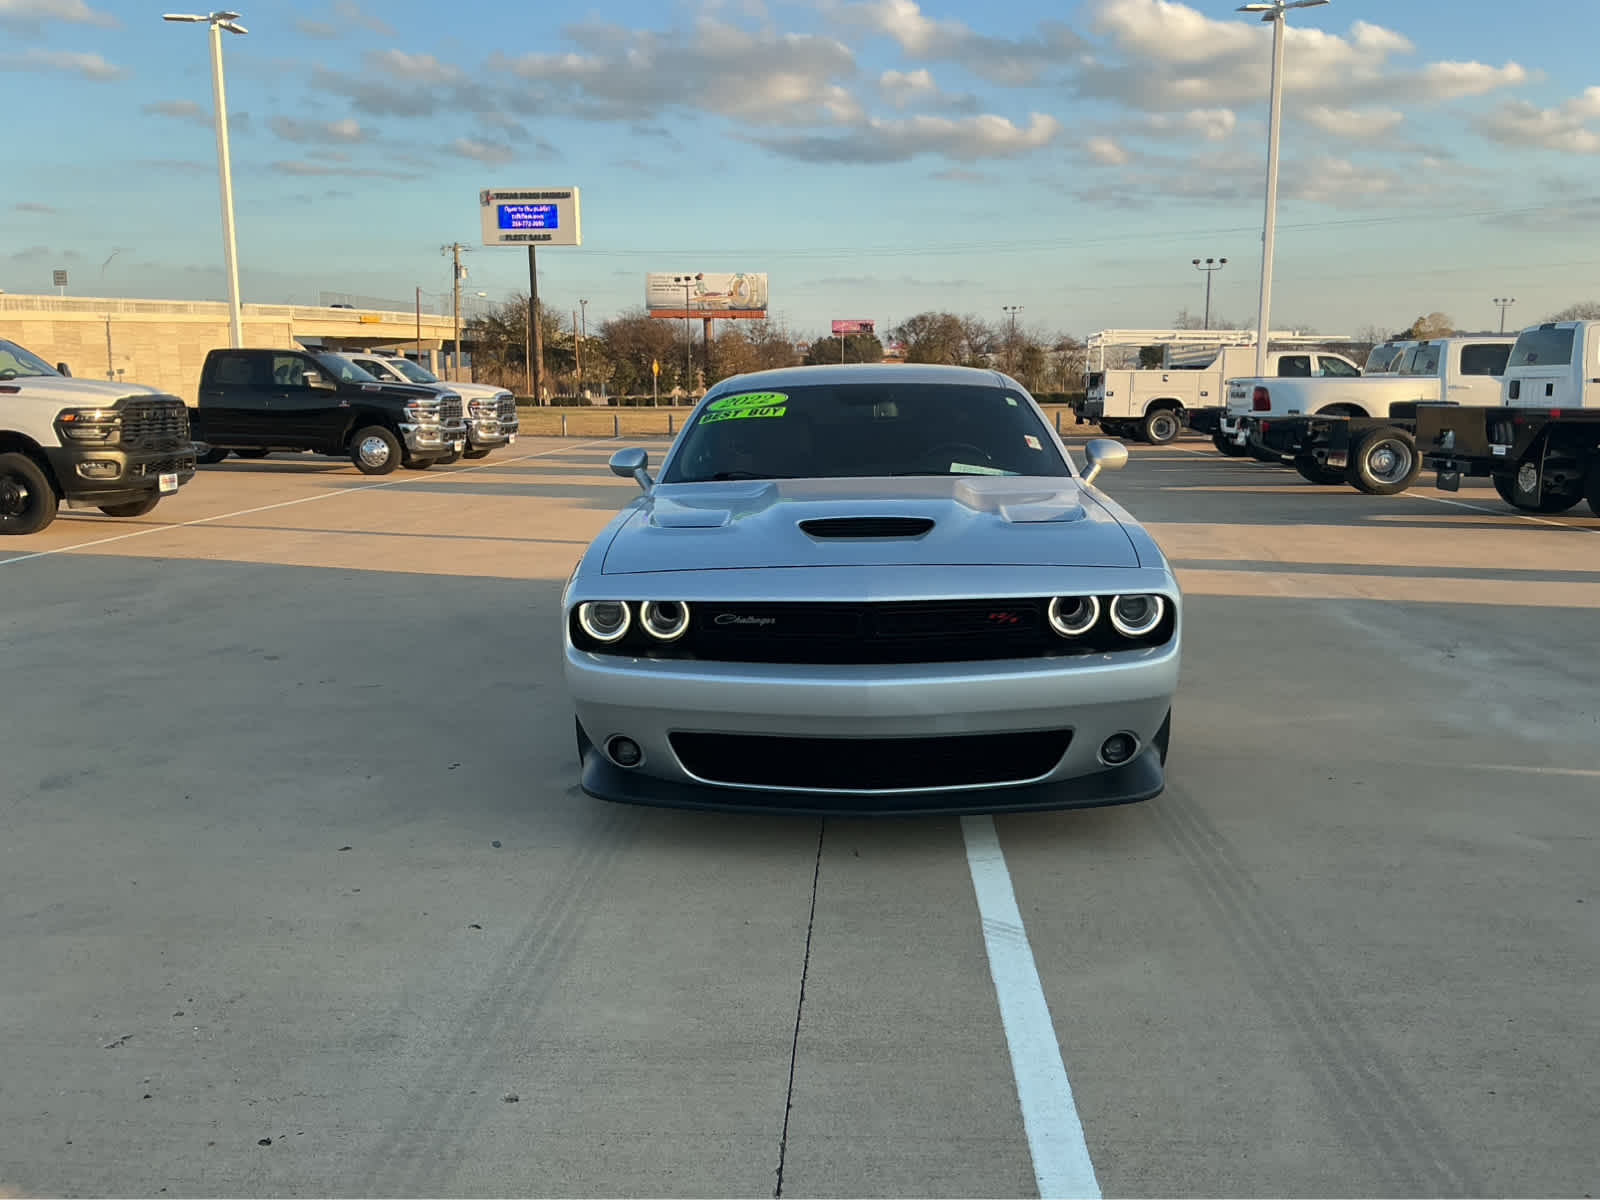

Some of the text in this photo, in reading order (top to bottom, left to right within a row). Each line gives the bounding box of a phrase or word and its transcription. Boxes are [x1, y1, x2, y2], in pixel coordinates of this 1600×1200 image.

[718, 394, 776, 408] 2022
[703, 407, 780, 423] BEST BUY
[713, 613, 777, 627] Challenger
